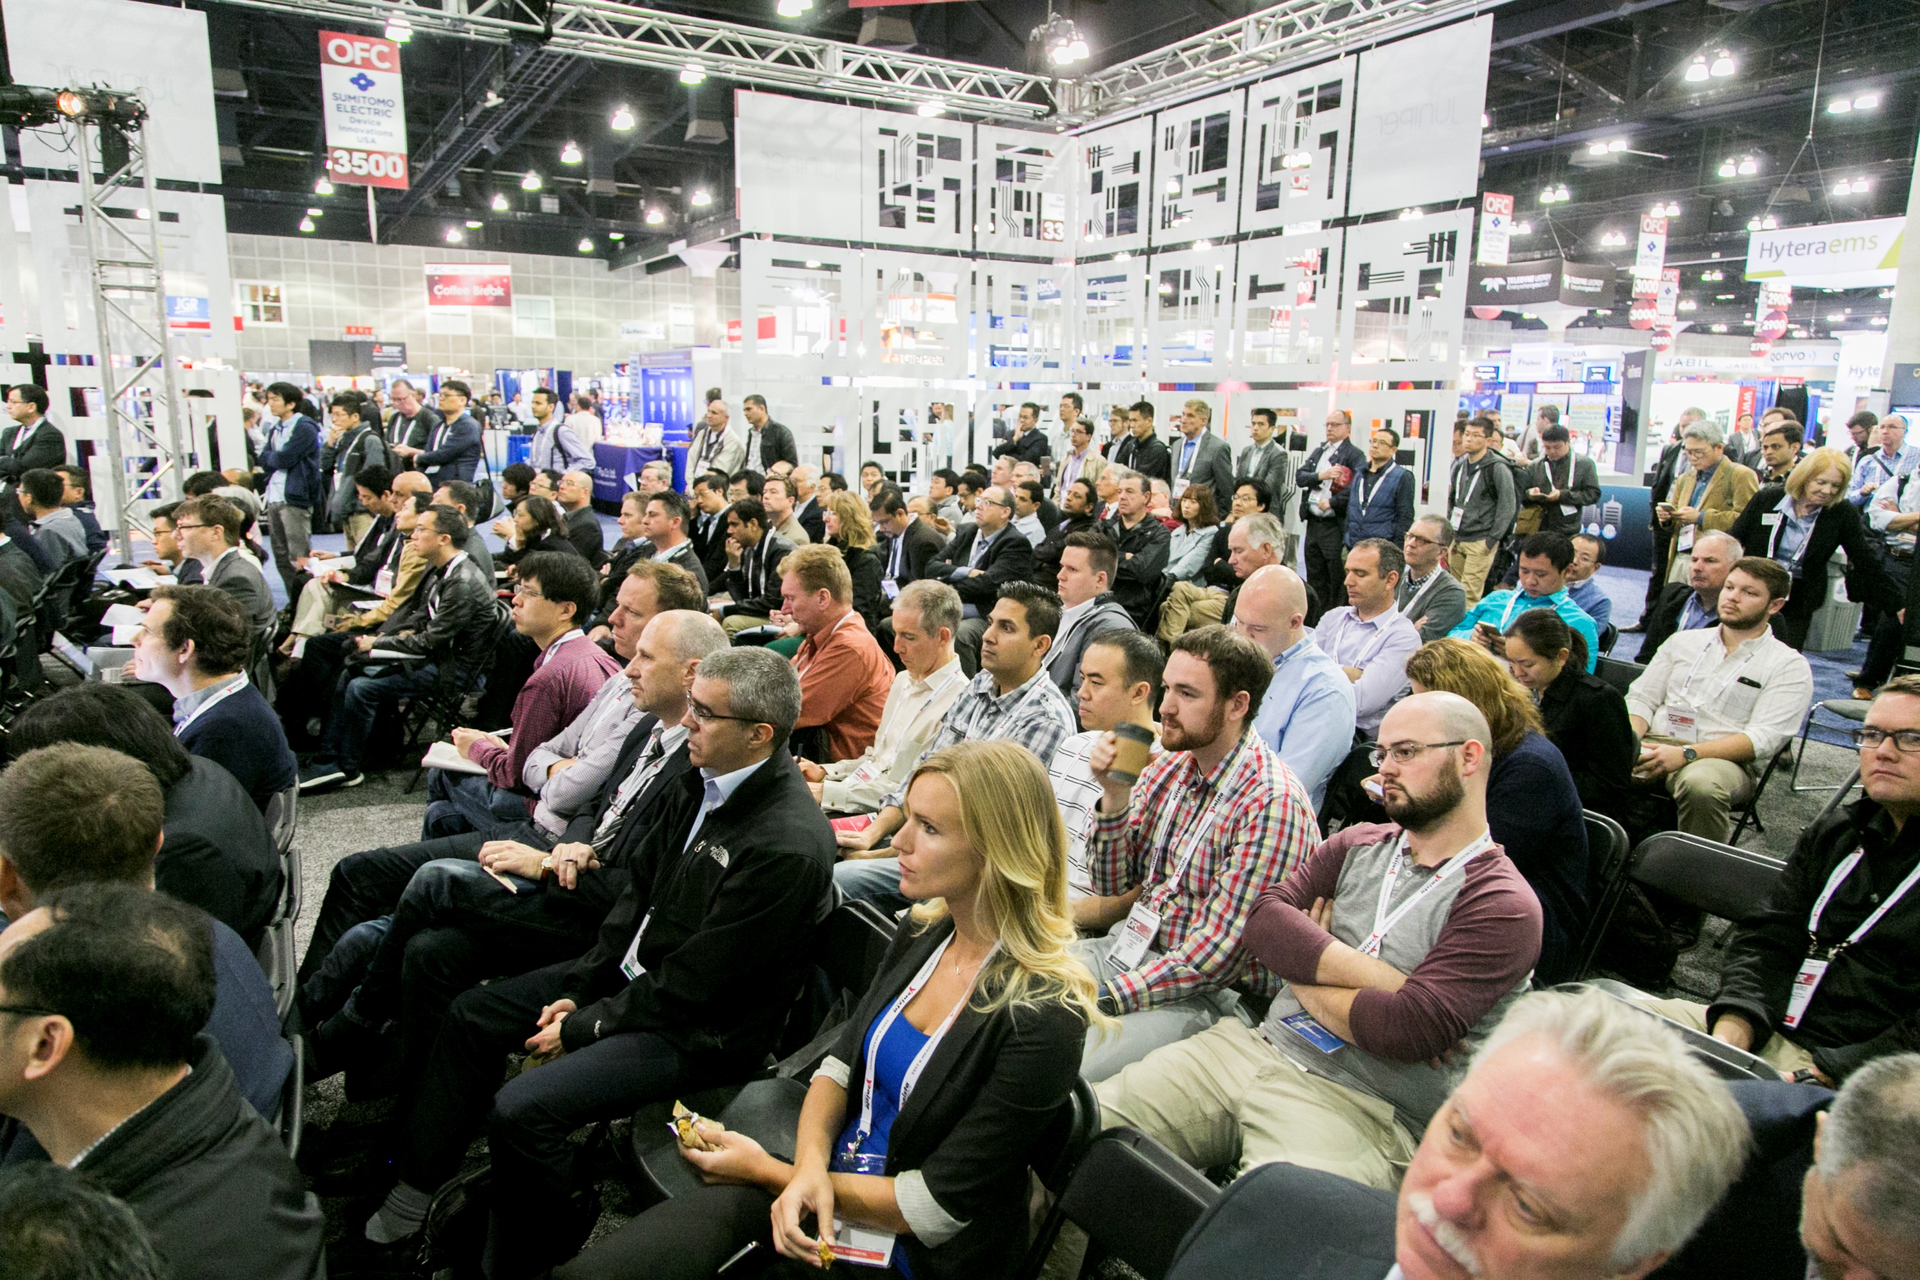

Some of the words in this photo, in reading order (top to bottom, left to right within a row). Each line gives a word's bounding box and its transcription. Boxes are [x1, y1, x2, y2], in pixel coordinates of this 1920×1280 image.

[327, 38, 392, 69] OFC
[332, 92, 395, 108] SUMITOMO
[336, 103, 392, 118] ELECTRIC
[349, 116, 381, 127] Device
[338, 124, 393, 138] Innovations
[356, 135, 377, 144] USA
[333, 150, 404, 179] 3500
[1486, 197, 1510, 214] OFC
[1643, 218, 1664, 234] OFC
[1662, 271, 1678, 282] OFC
[433, 284, 470, 296] Coffee
[473, 284, 505, 297] Break
[1634, 279, 1659, 294] 3000
[1629, 308, 1657, 321] 3000
[1762, 319, 1786, 331] 2900
[1651, 336, 1671, 346] 2800
[1750, 342, 1771, 352] 2700
[1664, 358, 1713, 369] JABIL
[1725, 362, 1761, 370] JABIL
[1209, 792, 1224, 814] Yenista
[1128, 919, 1141, 932] OFC
[893, 986, 916, 1013] Yenista
